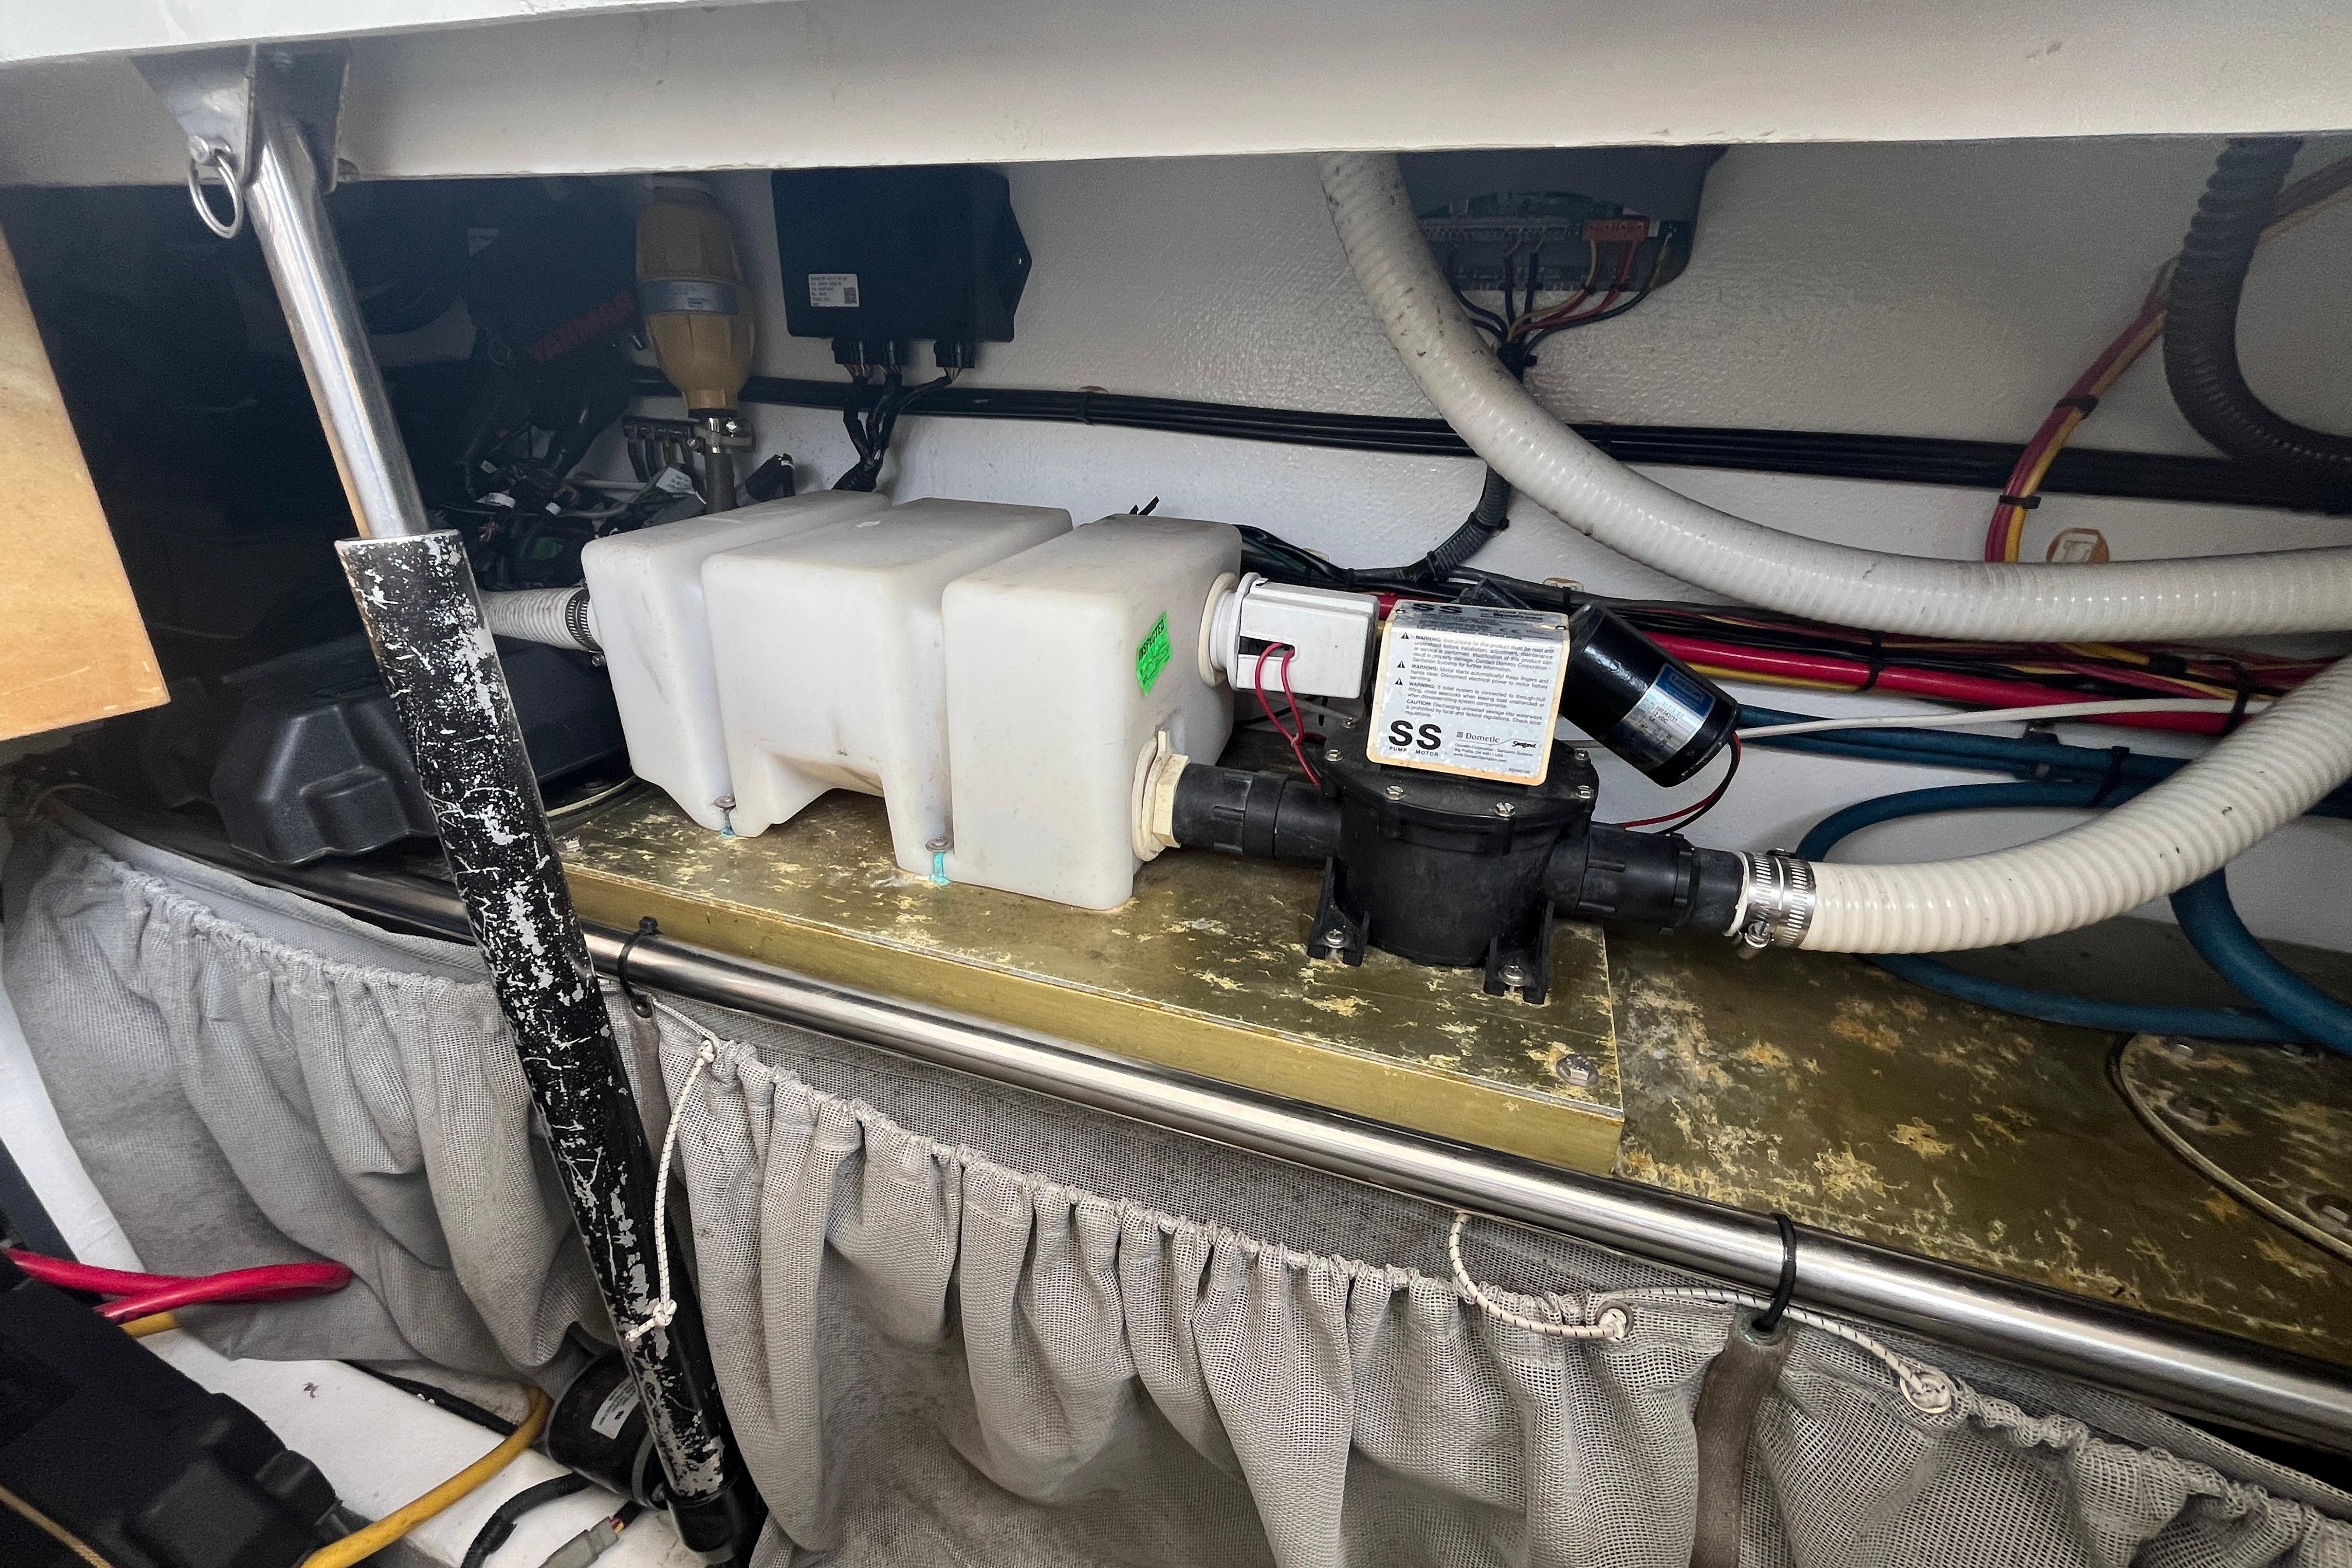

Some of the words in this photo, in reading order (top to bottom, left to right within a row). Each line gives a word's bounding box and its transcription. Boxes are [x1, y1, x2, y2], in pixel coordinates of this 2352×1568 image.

[1138, 618, 1164, 661] INSPECTED
[1420, 694, 1457, 703] disassembling
[1433, 702, 1460, 710] Discharging
[1465, 732, 1500, 744] Dometic
